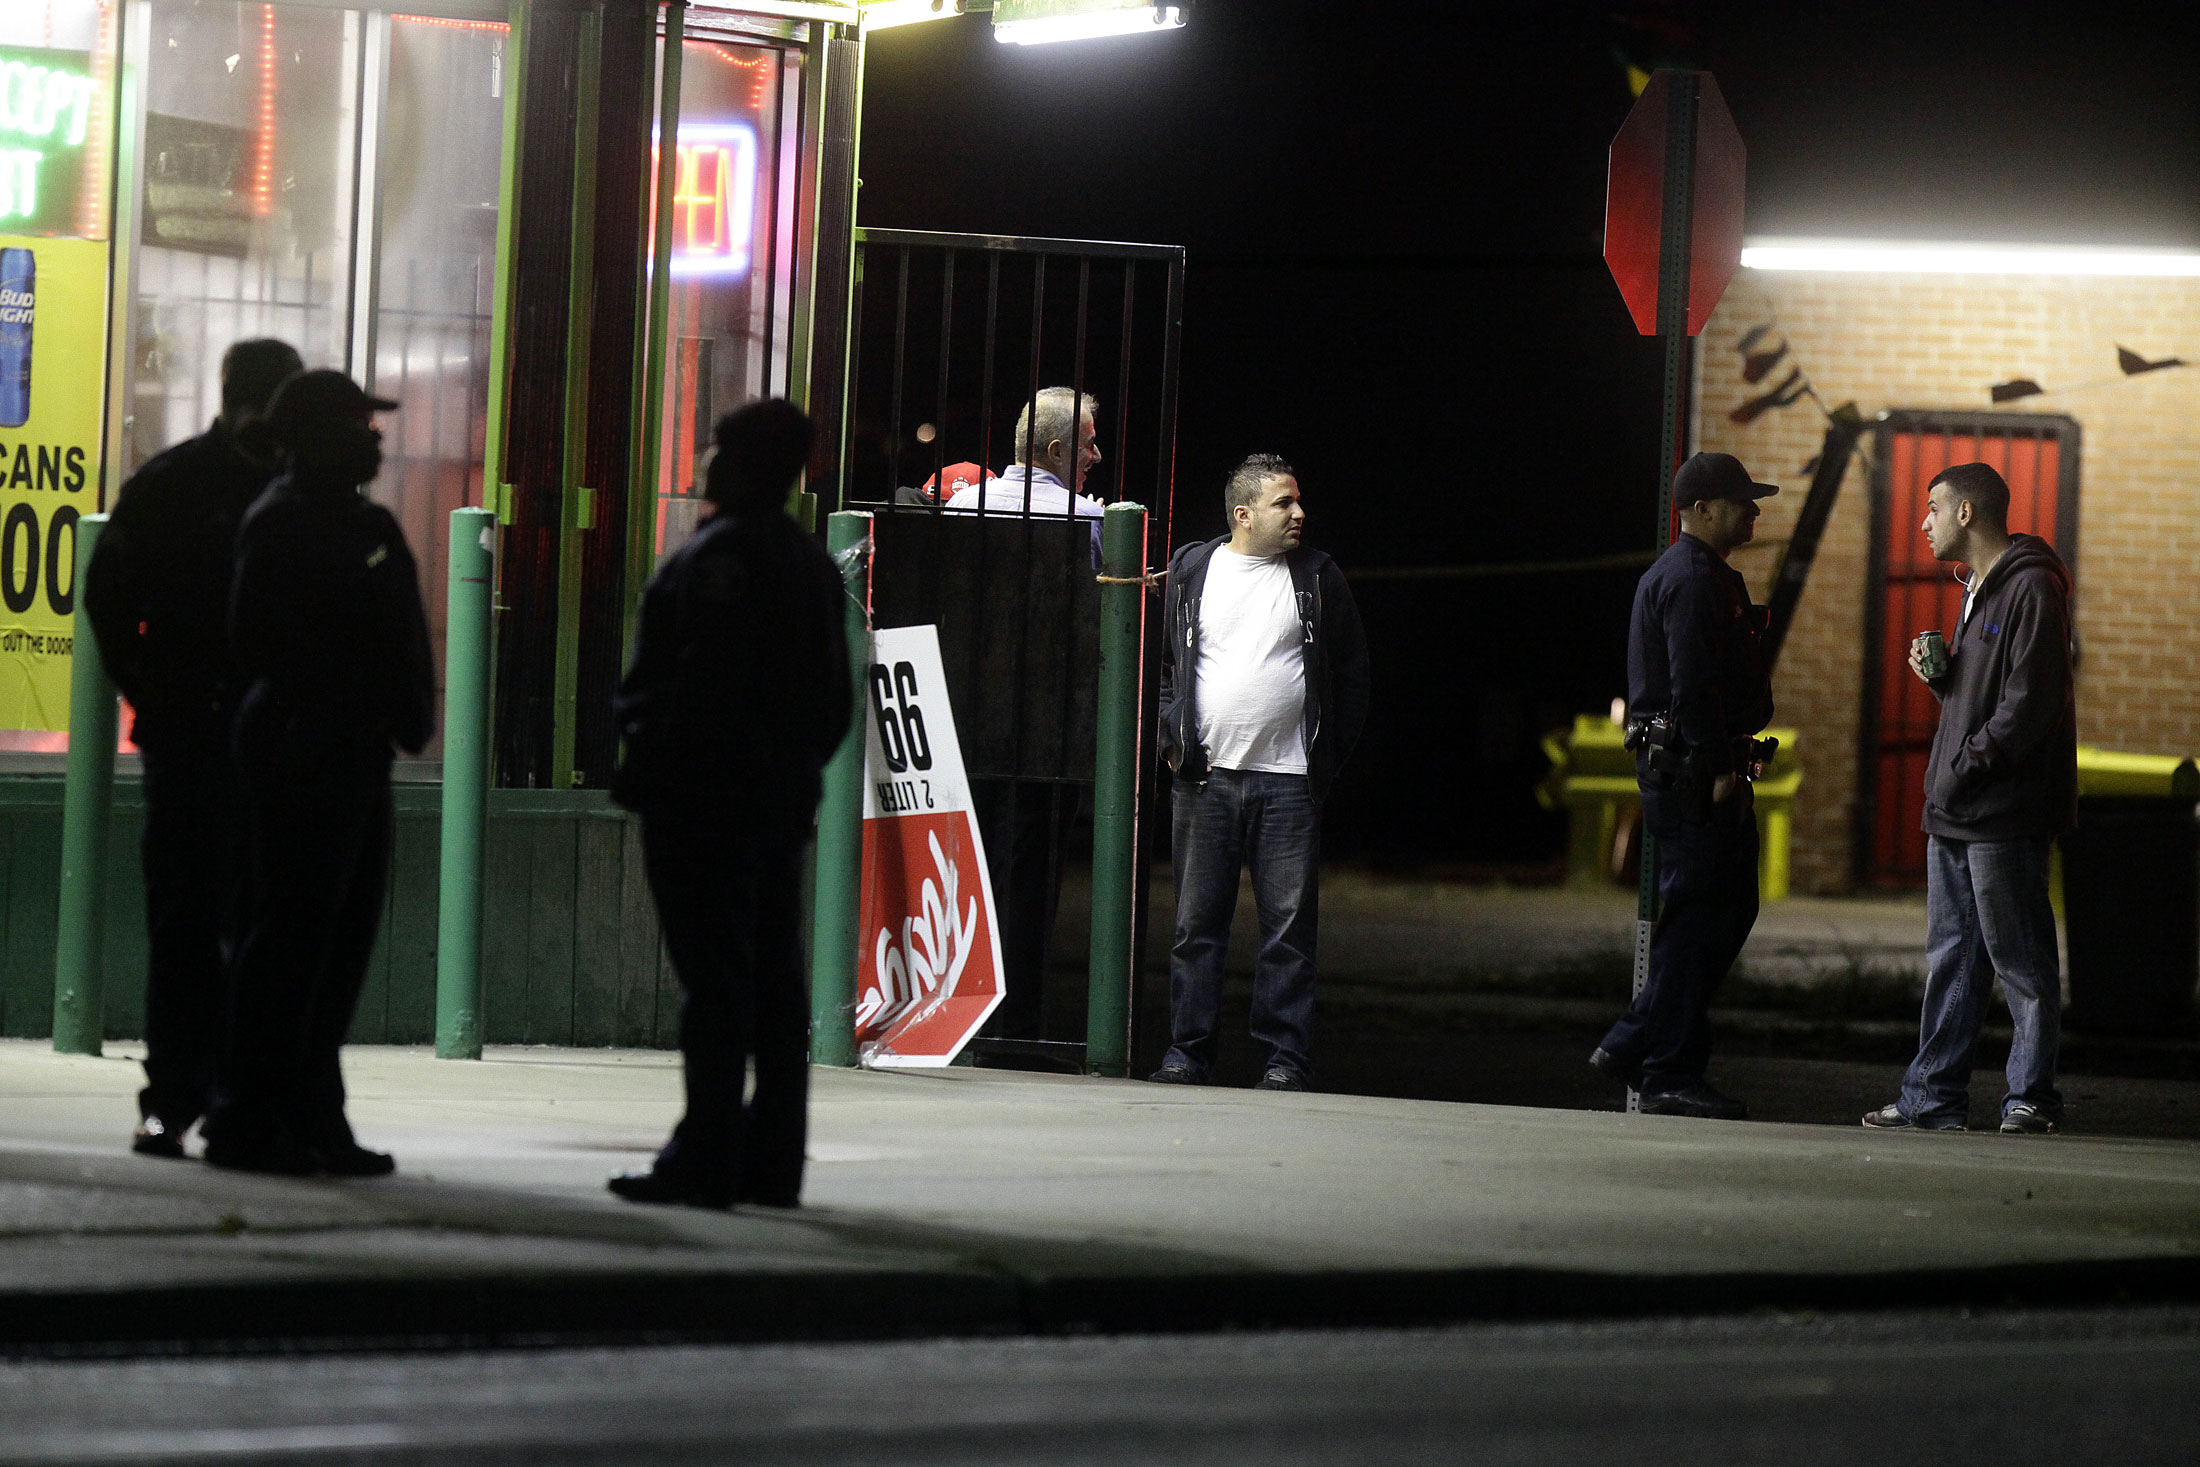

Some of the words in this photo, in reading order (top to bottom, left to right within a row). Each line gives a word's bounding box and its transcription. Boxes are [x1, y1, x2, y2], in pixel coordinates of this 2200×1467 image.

[0, 58, 98, 145] CEPT
[0, 289, 34, 307] BUD
[3, 634, 23, 652] OUT
[26, 635, 43, 653] THE
[876, 781, 918, 812] LITER
[920, 779, 934, 809] 2
